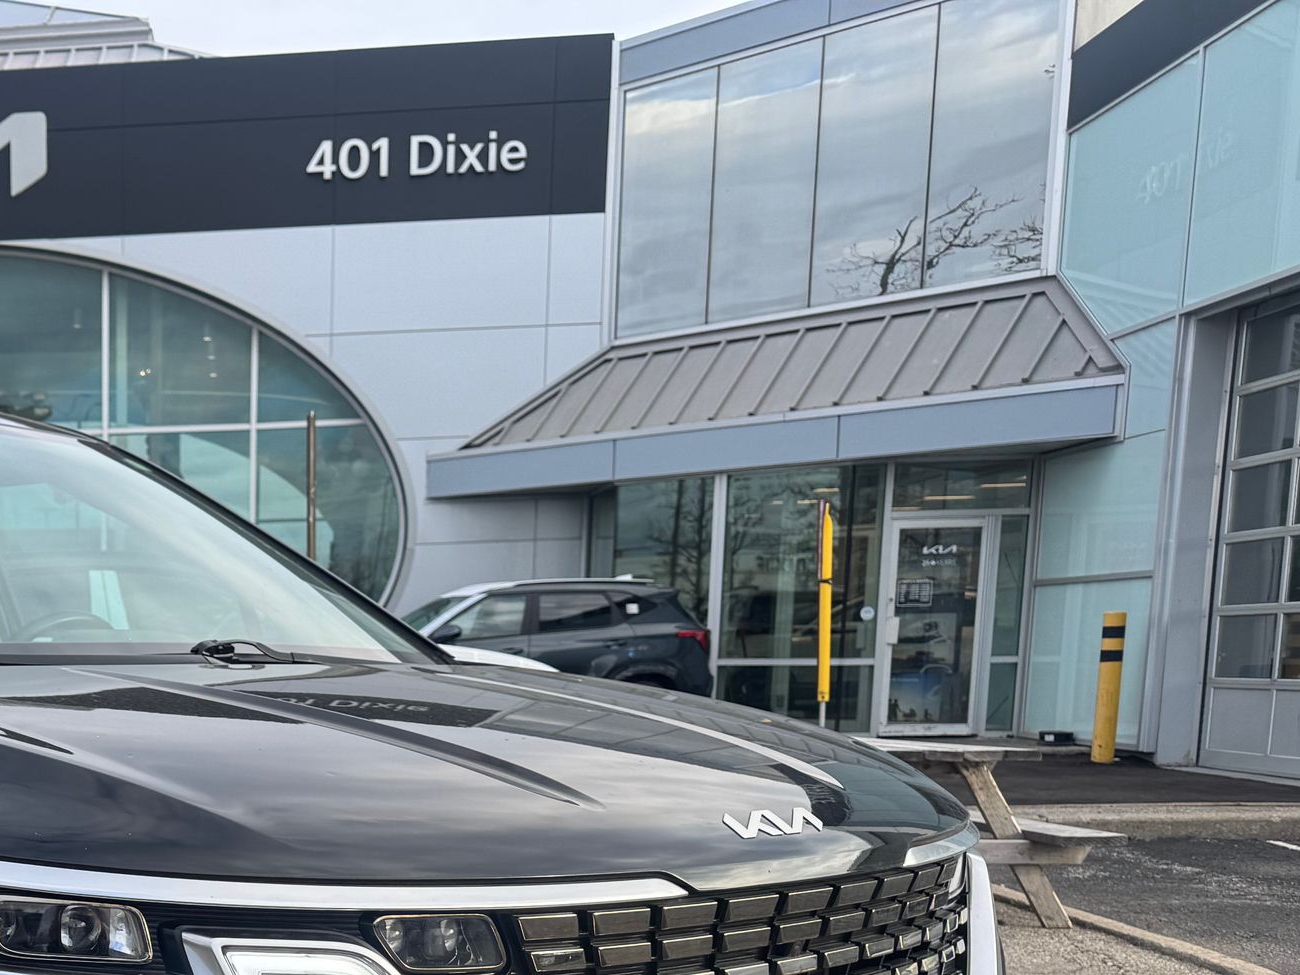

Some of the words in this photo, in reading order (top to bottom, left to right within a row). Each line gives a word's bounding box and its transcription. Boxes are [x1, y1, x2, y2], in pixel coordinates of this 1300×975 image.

[306, 136, 391, 181] 401
[409, 130, 528, 176] Dixie
[922, 544, 957, 555] KIA
[722, 807, 824, 839] KIA
